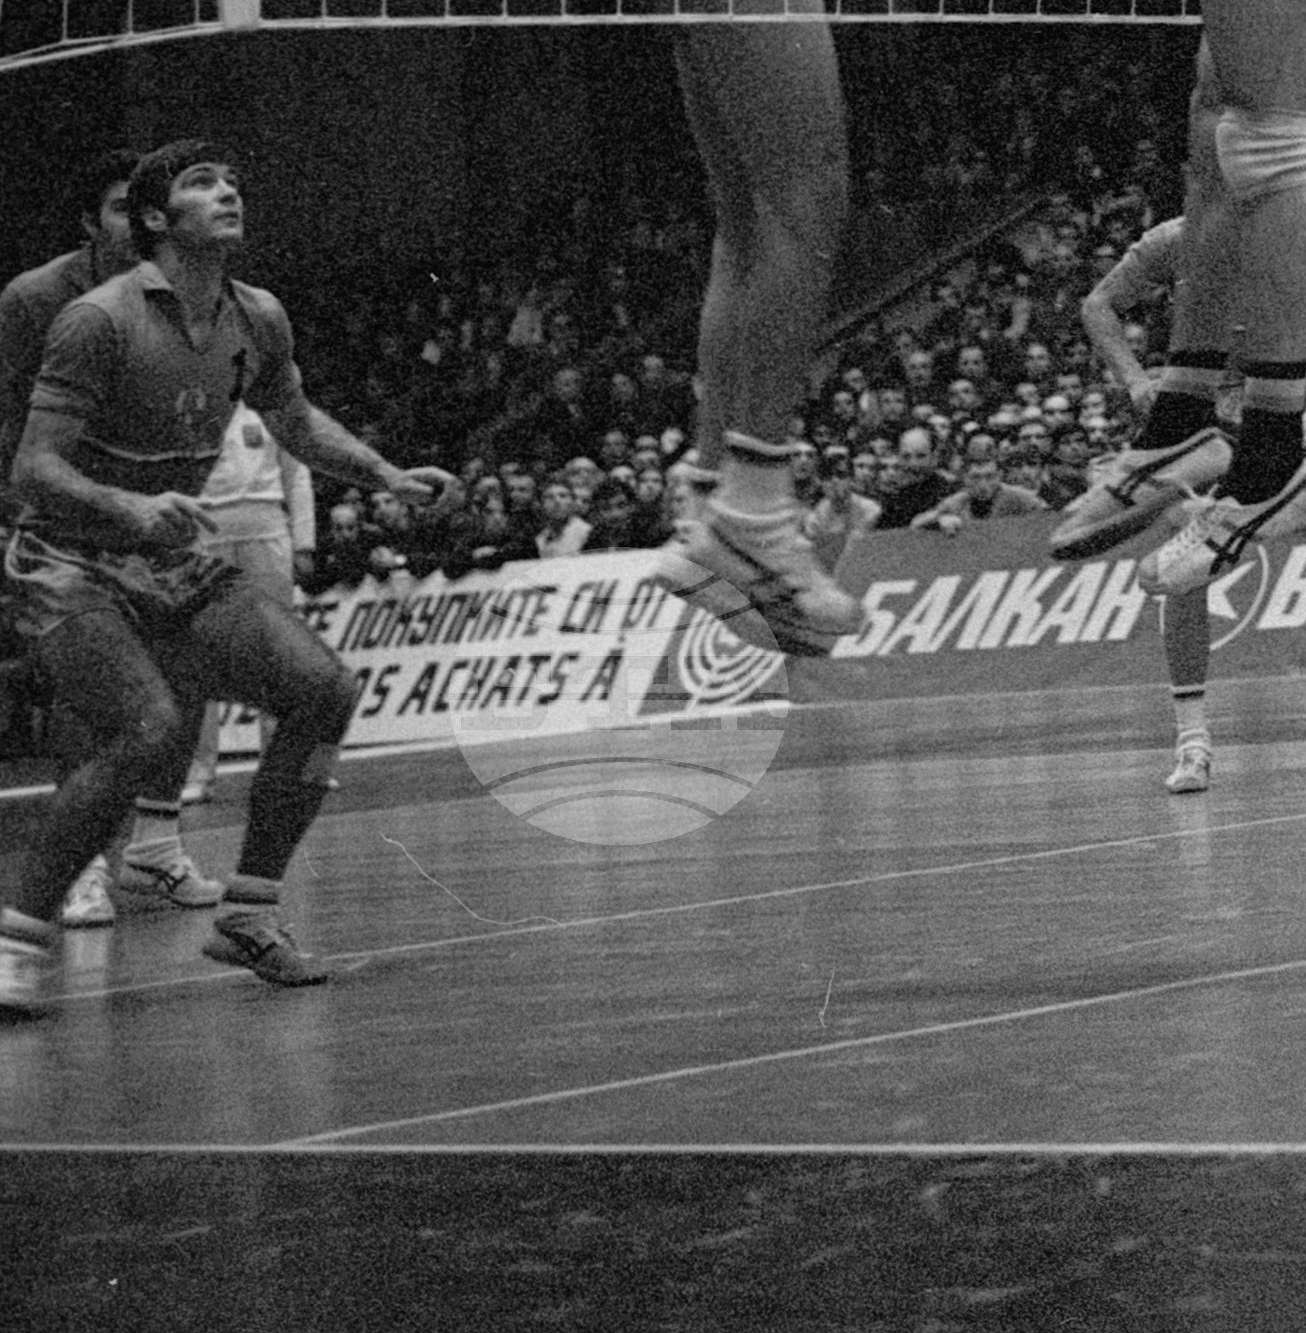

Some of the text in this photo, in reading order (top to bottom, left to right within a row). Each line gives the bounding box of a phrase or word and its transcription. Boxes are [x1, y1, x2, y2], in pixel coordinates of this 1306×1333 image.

[229, 348, 247, 402] 1
[830, 559, 1147, 658] БАЛКАН
[396, 650, 580, 716] ACHATS
